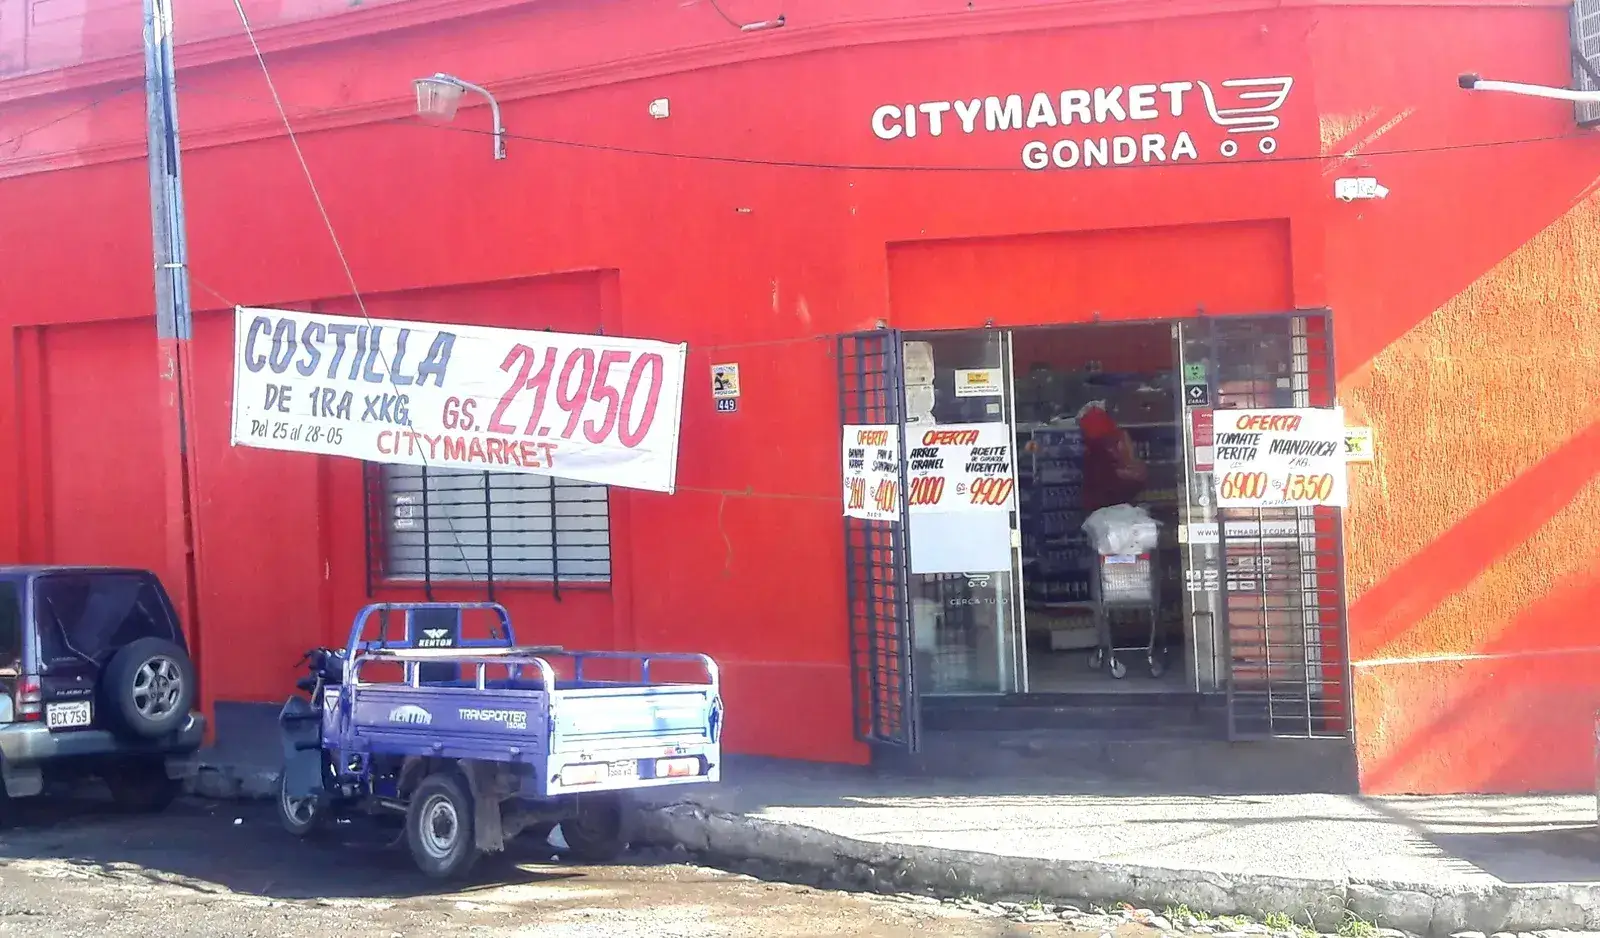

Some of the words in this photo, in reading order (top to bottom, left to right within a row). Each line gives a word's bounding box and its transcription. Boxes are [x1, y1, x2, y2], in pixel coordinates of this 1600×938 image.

[871, 81, 1194, 140] CITYMARKET
[1021, 131, 1198, 170] GONDRA
[244, 316, 457, 387] COSTILLA
[264, 383, 292, 413] DE
[309, 386, 354, 421] 1RA
[442, 396, 480, 431] GS.
[487, 343, 664, 448] 21.950
[718, 399, 735, 410] 449
[1236, 414, 1303, 432] OFERTA
[251, 420, 269, 437] Del
[272, 422, 289, 439] 25
[290, 423, 303, 441] al
[305, 425, 343, 445] 28-05
[857, 430, 888, 446] OFERTA
[922, 429, 980, 446] OFERTA
[1216, 432, 1262, 446] TOMATE
[376, 430, 558, 468] CITYMARKET
[910, 447, 940, 458] ARROZ
[970, 446, 1007, 456] ACEITE
[1217, 446, 1258, 461] PERITA
[1269, 438, 1338, 457] MANDIOCA
[911, 458, 944, 470] GRANEL
[965, 462, 1009, 473] VICENTIN
[908, 476, 945, 505] 2.000
[970, 476, 1014, 506] 9.900
[1220, 471, 1269, 499] 6.900
[1282, 472, 1335, 502] 1.350
[418, 638, 452, 647] KENTON
[51, 712, 67, 724] BCX
[70, 710, 87, 724] 759
[389, 709, 433, 726] KENTON
[458, 708, 527, 723] TRANSPORTER
